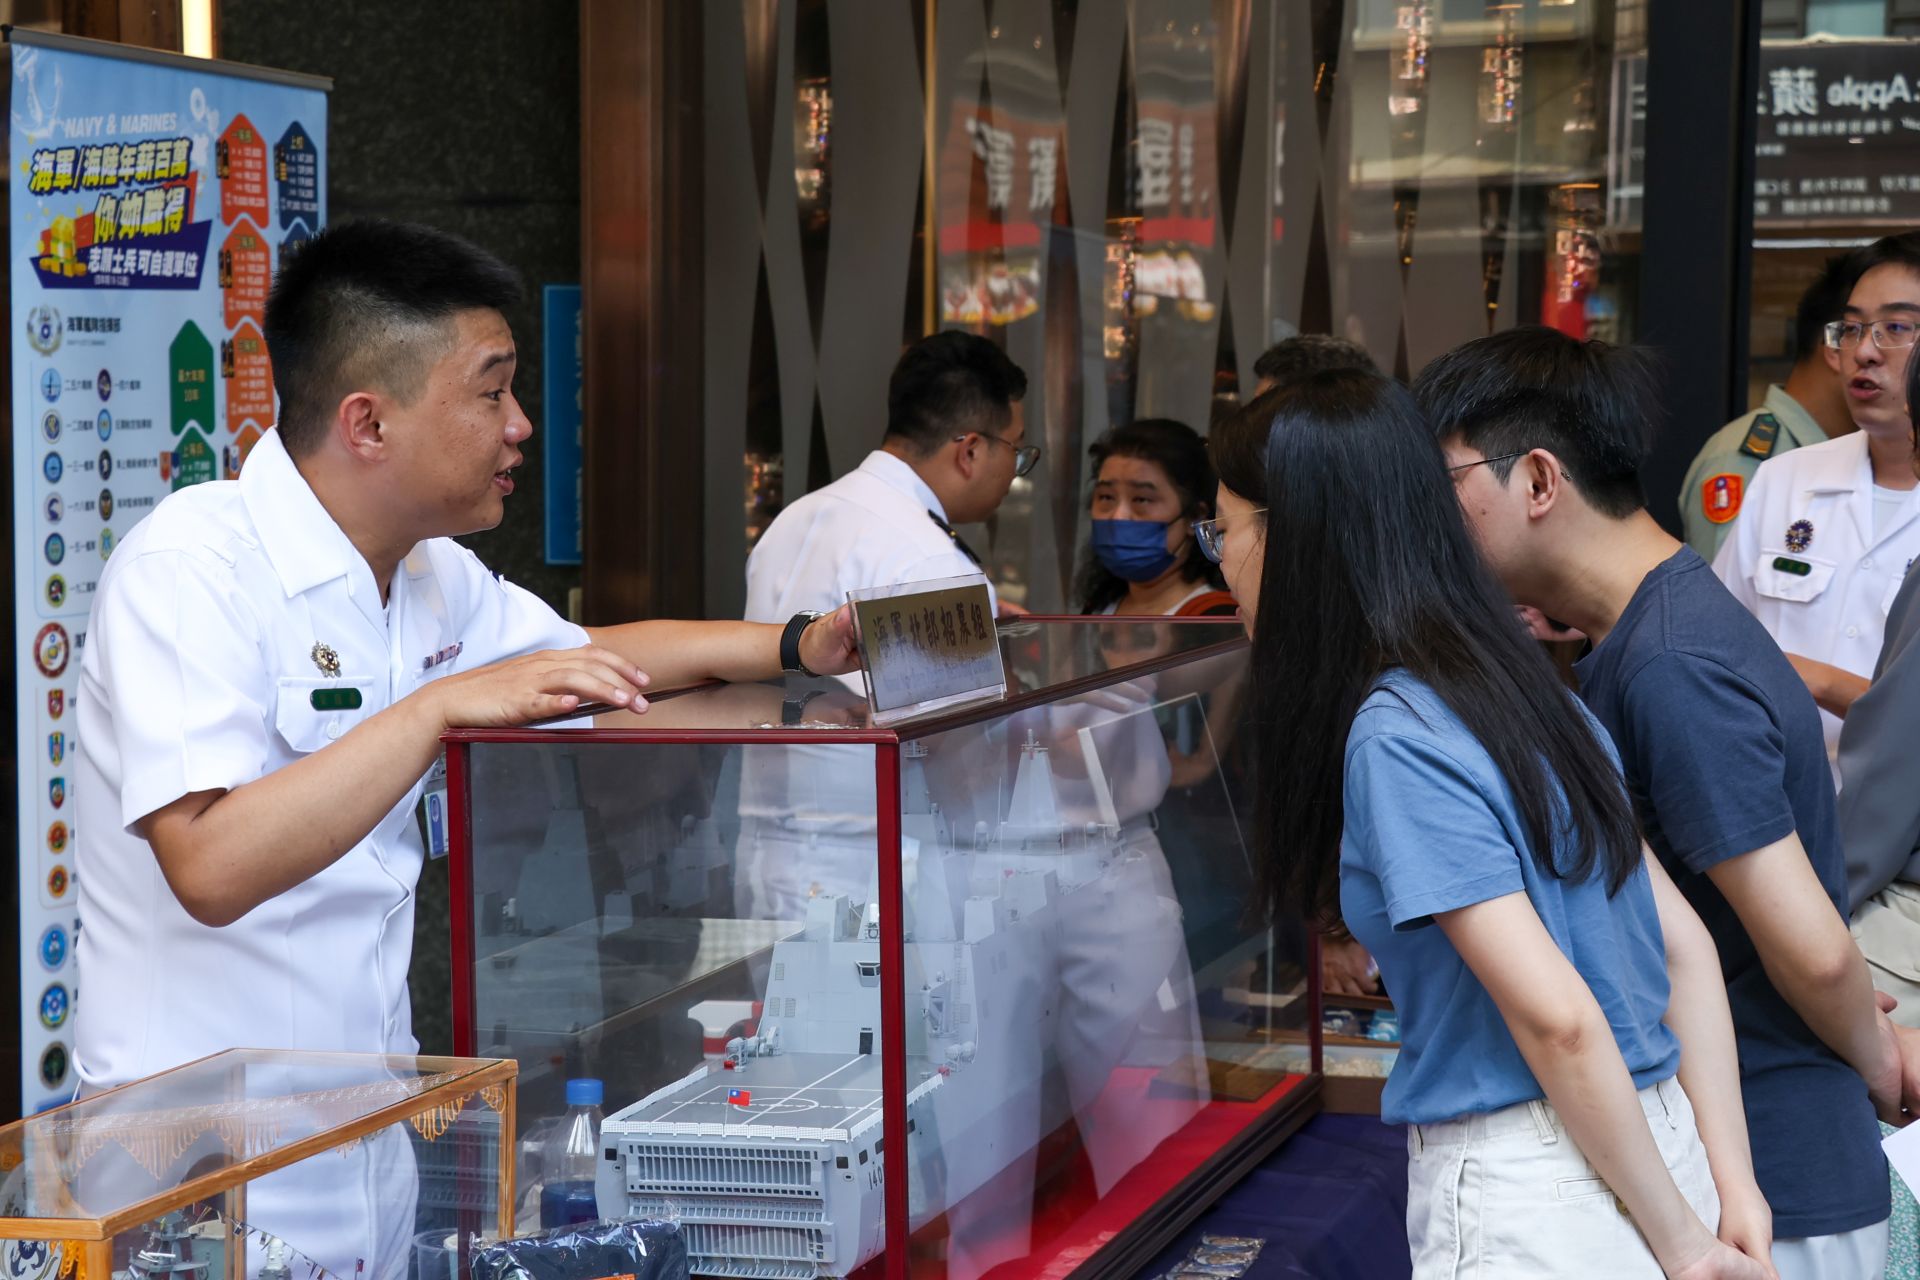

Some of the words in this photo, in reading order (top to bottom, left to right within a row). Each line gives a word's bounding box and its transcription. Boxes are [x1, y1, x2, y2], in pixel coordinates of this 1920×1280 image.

[66, 117, 104, 138] NAVY
[106, 114, 116, 135] &
[121, 112, 177, 134] MARINES
[89, 248, 198, 276] 志願士兵可自選單位
